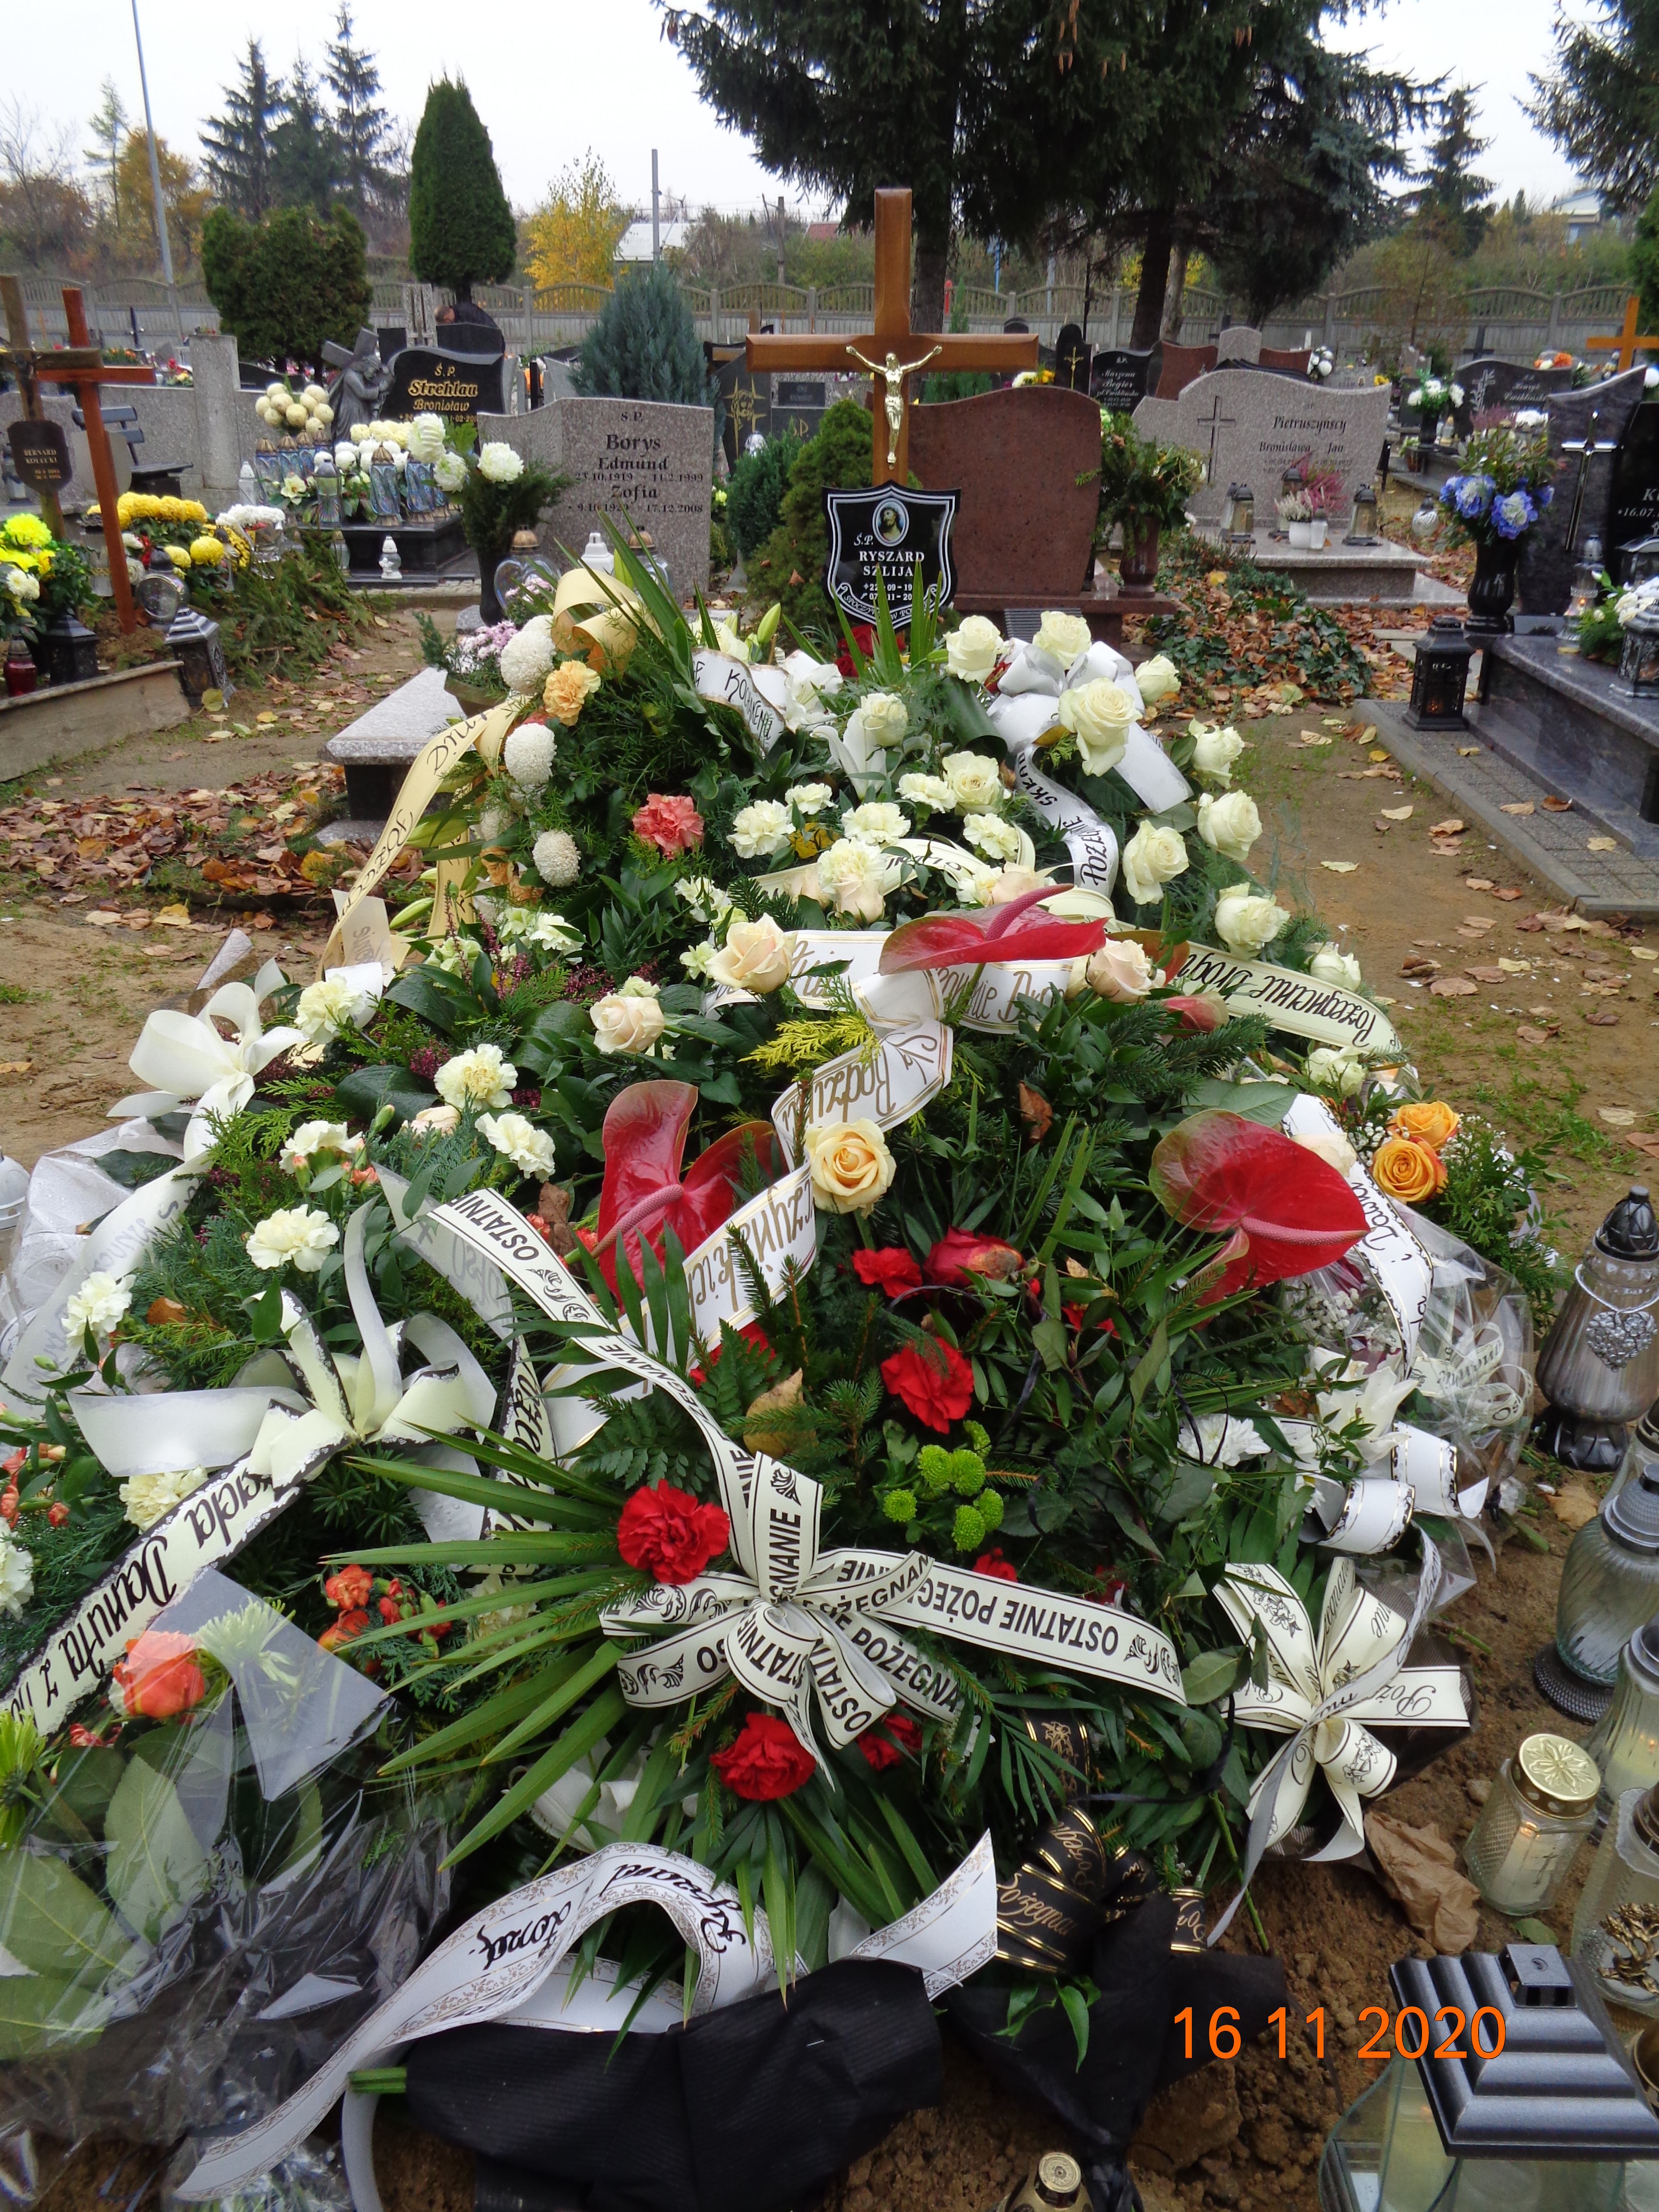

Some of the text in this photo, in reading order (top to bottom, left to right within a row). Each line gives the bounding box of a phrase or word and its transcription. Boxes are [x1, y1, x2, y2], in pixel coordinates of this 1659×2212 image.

[606, 434, 661, 457] Borys
[598, 456, 669, 470] Edmund
[611, 484, 658, 503] Zofia
[859, 551, 924, 562] RYSZARD
[863, 565, 913, 576] SZLIJA
[1000, 1599, 1118, 1656] OSTATNIE
